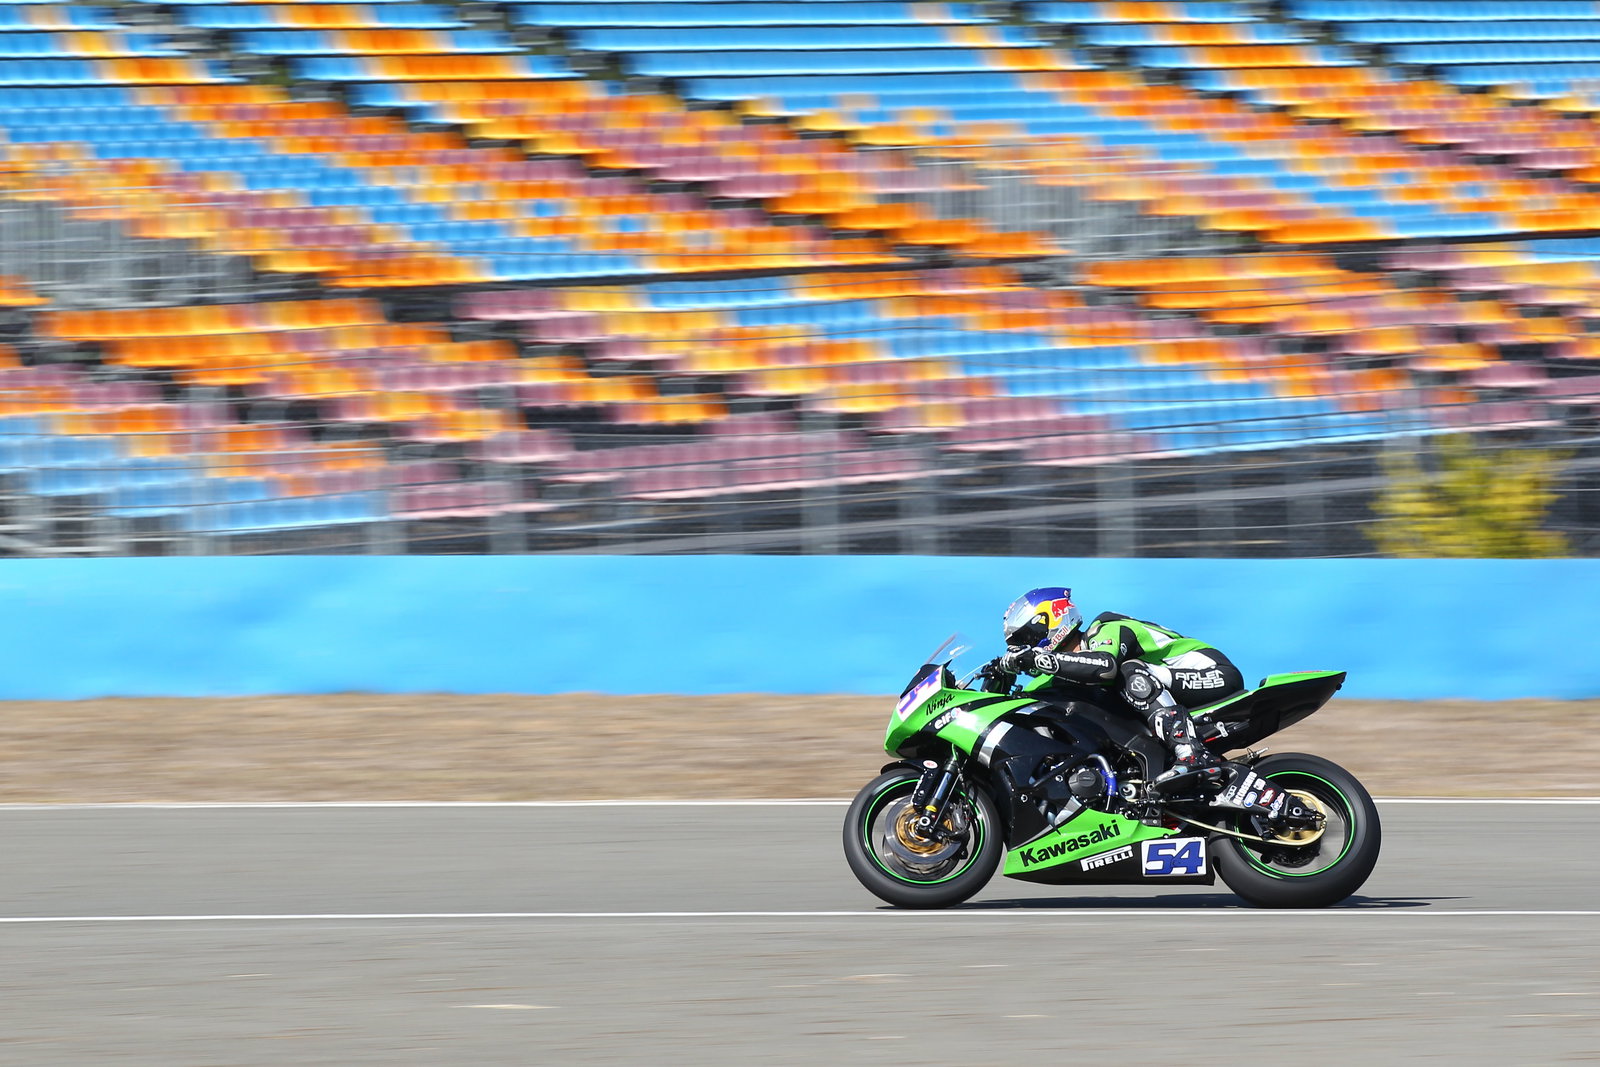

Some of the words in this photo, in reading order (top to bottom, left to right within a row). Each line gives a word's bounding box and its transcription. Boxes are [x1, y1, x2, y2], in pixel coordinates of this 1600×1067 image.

[1044, 637, 1058, 652] Red
[1055, 625, 1069, 640] Bull
[1055, 652, 1109, 668] Kawasaki
[1182, 678, 1225, 690] NESS
[925, 693, 955, 716] Ninja
[1019, 819, 1121, 867] Kawasaki
[1080, 845, 1134, 872] PIRELLI
[1145, 841, 1204, 875] 54
